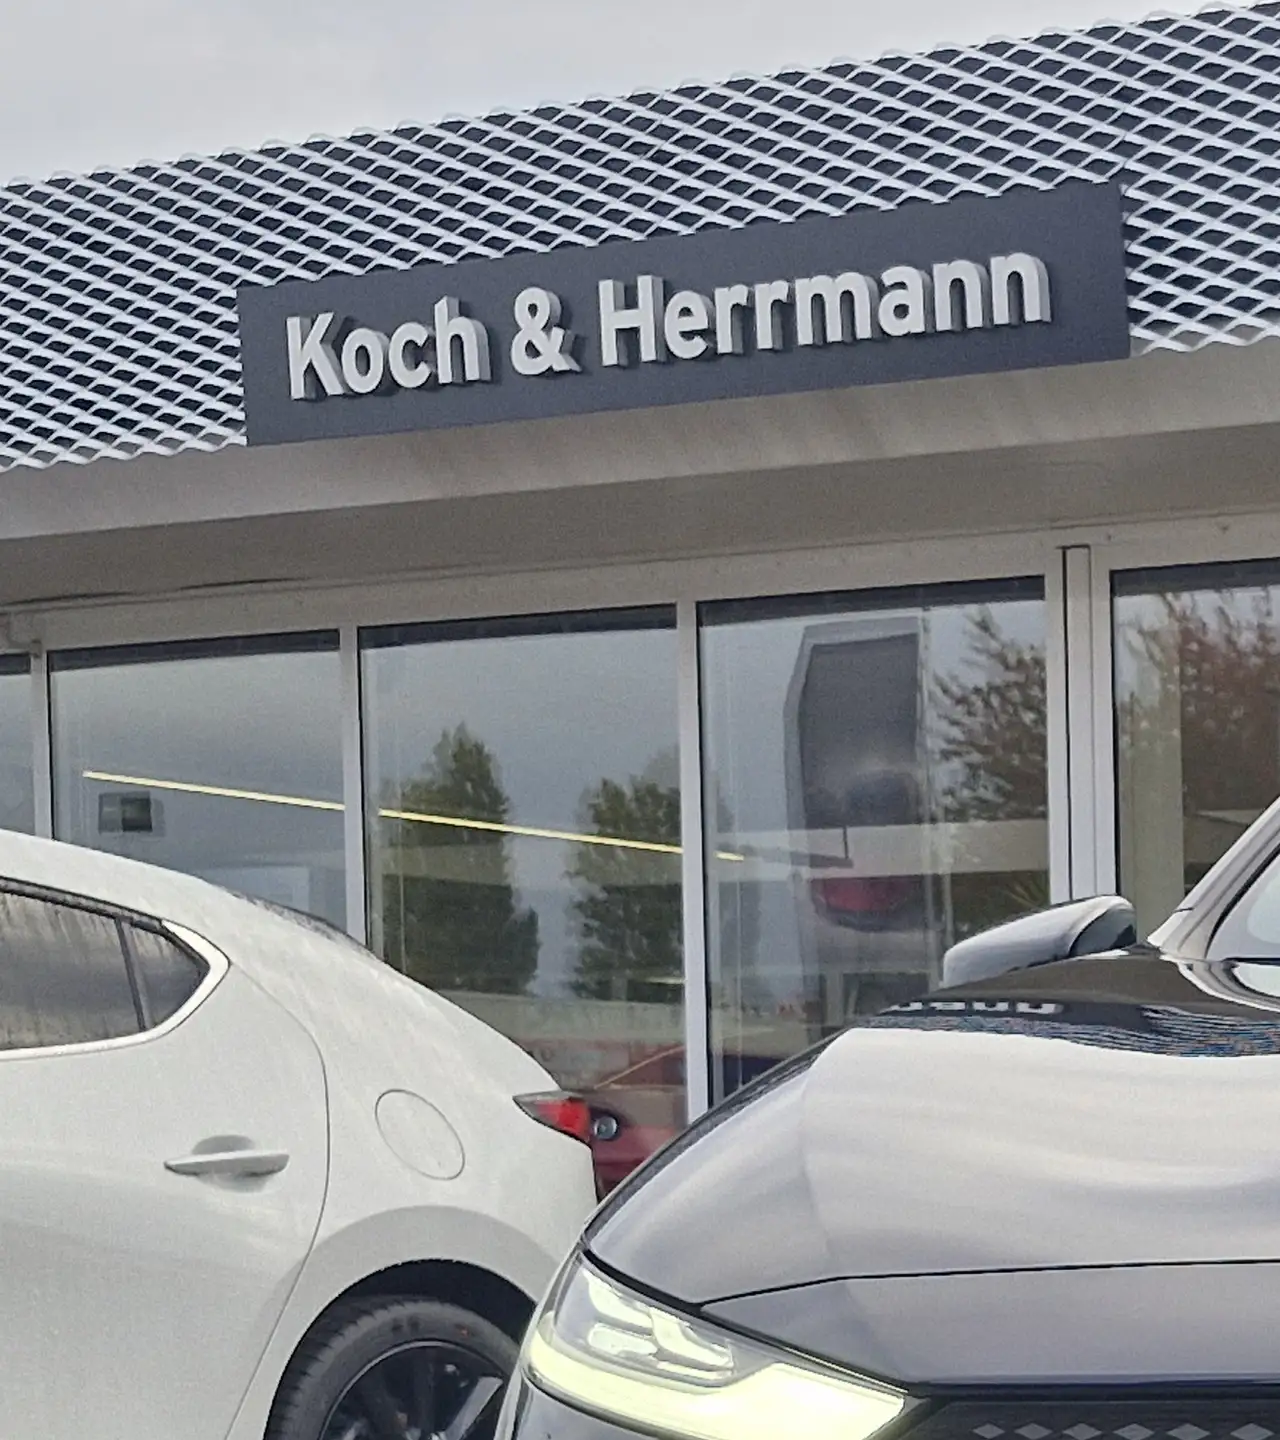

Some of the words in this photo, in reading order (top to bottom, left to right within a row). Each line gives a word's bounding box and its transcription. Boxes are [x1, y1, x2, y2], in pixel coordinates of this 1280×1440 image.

[286, 296, 490, 400] Koch
[510, 287, 582, 376] &
[598, 252, 1052, 367] Herrmann
